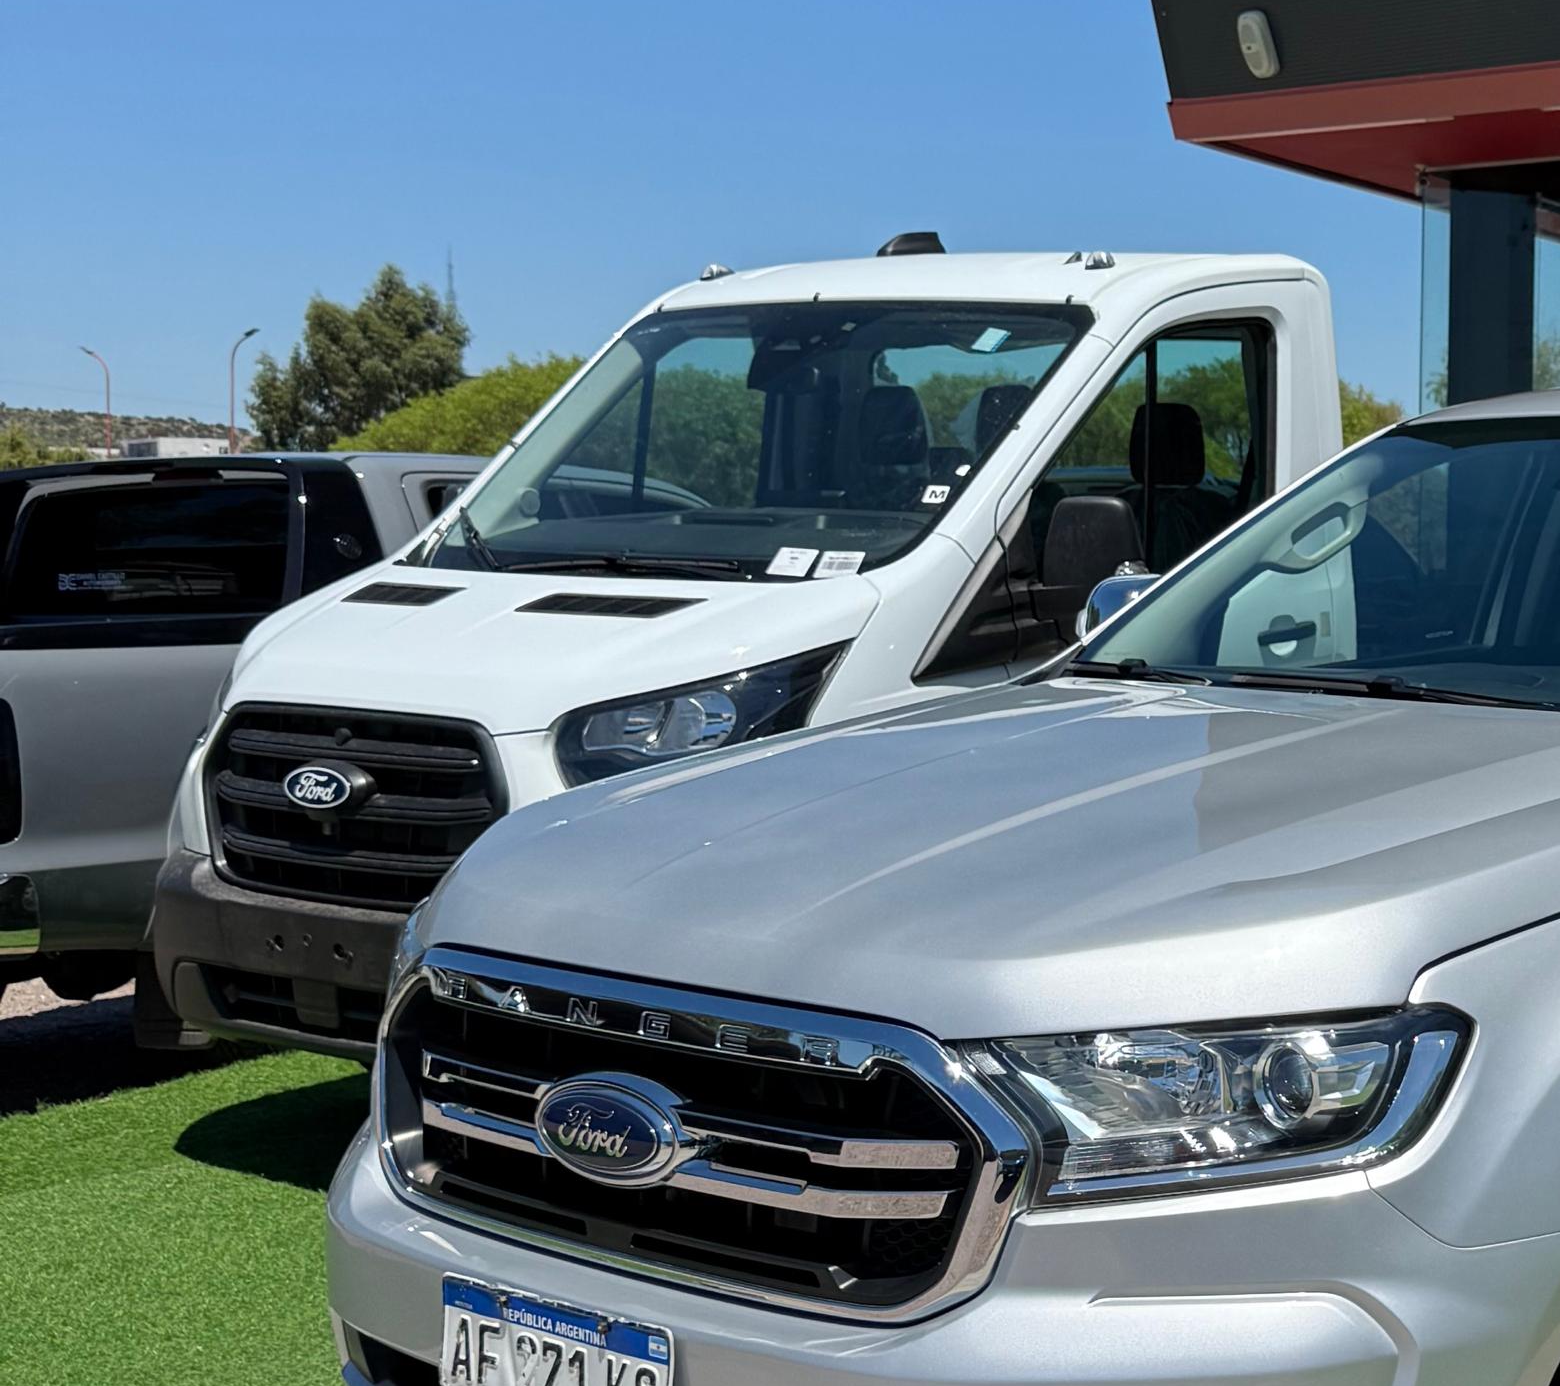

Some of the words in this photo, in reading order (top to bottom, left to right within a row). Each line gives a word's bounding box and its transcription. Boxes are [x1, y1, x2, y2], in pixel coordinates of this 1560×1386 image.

[294, 772, 338, 802] Ford
[438, 967, 839, 1067] RANGER
[558, 1102, 629, 1159] Ford
[451, 1315, 503, 1386] AF
[503, 1308, 553, 1333] REPÚBLICA
[555, 1321, 607, 1348] ARGENTINA
